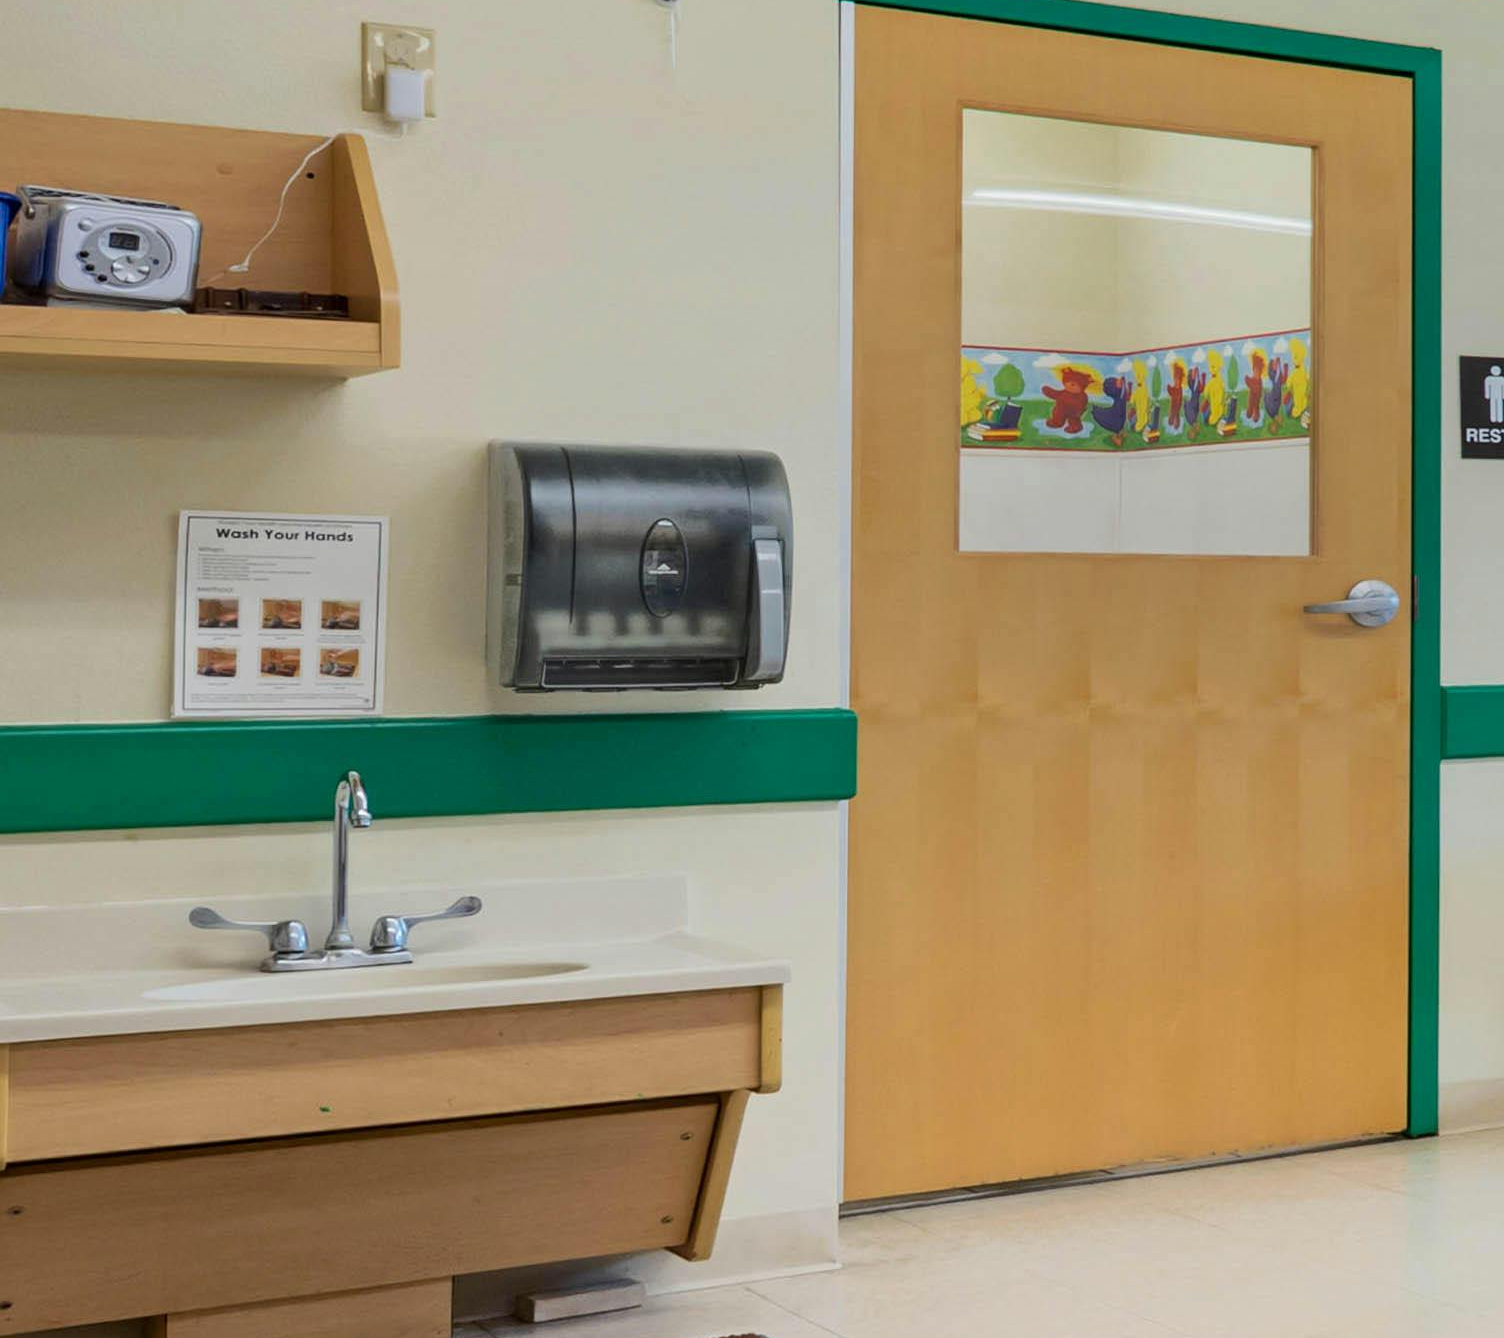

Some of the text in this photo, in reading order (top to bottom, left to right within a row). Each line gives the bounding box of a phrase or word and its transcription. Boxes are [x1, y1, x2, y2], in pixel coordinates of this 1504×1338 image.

[216, 528, 354, 542] Wash Your Hands
